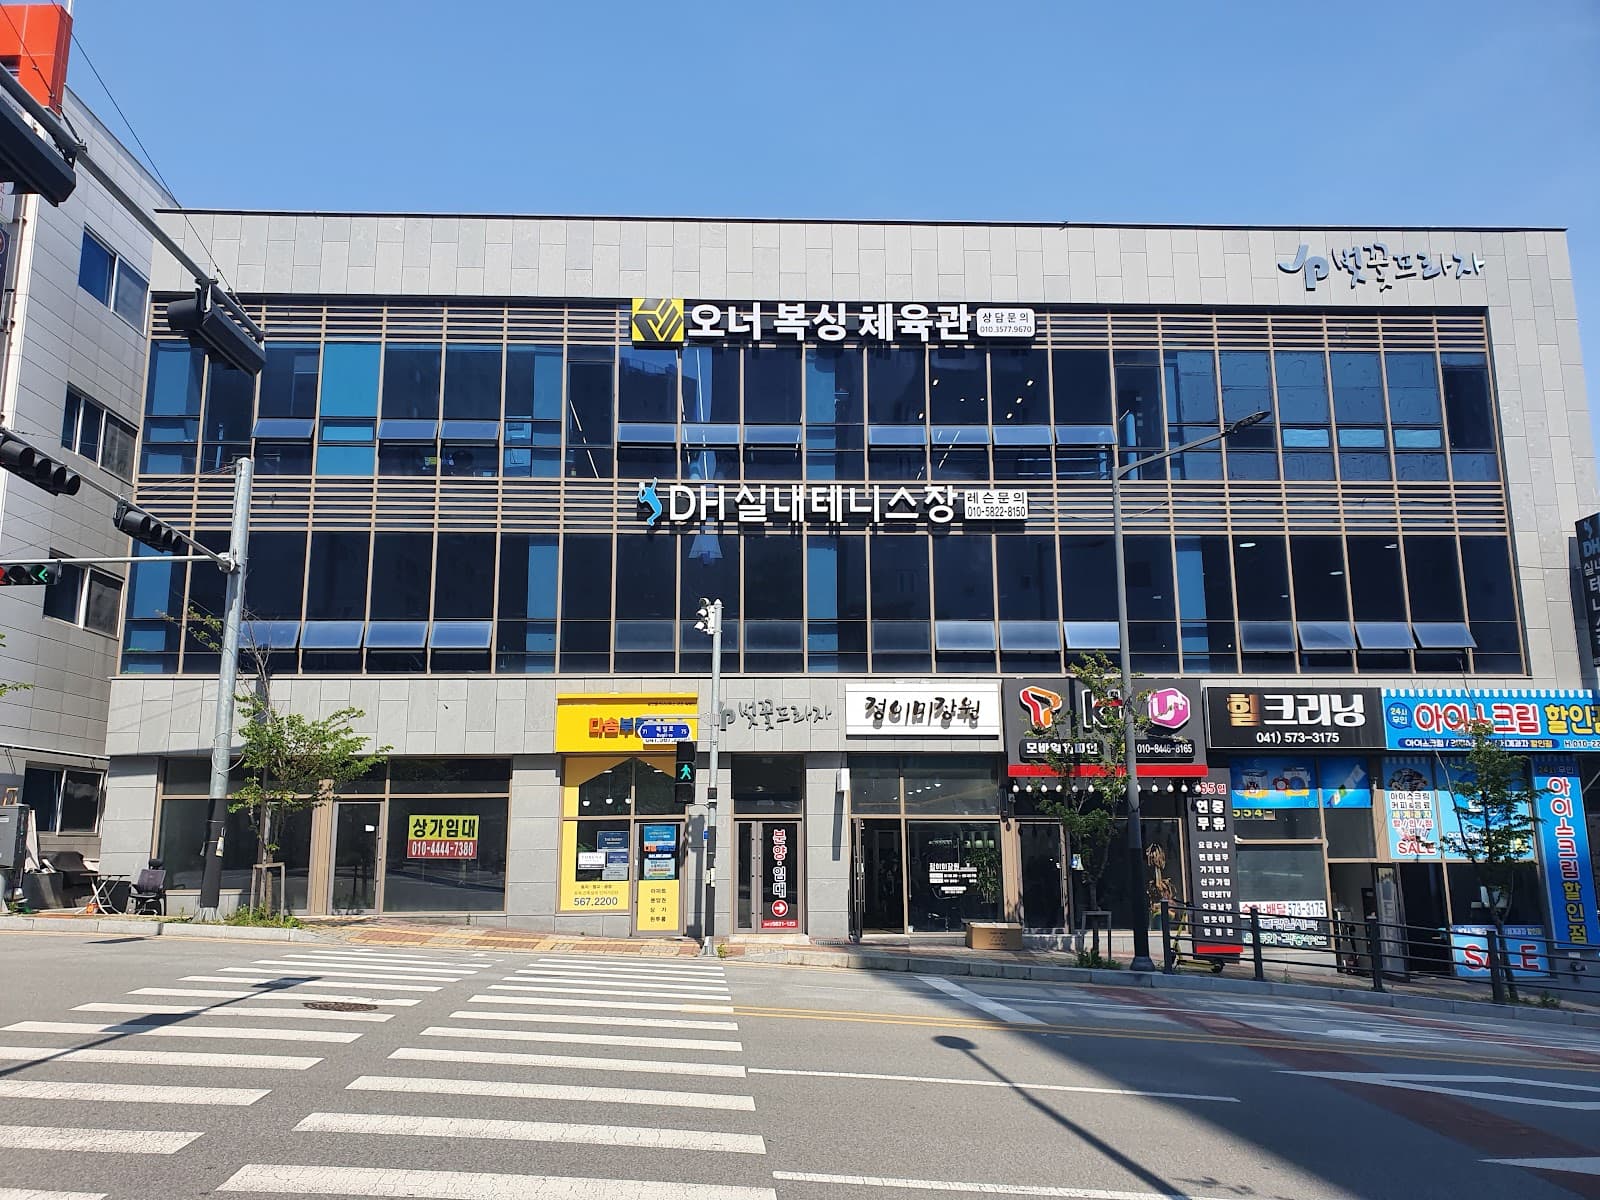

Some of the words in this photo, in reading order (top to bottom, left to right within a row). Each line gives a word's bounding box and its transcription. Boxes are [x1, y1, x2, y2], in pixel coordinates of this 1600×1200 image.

[687, 303, 761, 339] 오너
[774, 303, 846, 341] 복싱
[859, 303, 971, 341] 체육관
[982, 312, 1030, 324] 상담문의
[980, 325, 1032, 334] 010.3577.9670
[967, 491, 1025, 504] 레슨문의
[967, 505, 1027, 518] 010-5822-8150
[865, 697, 980, 728] 정이미장원
[1284, 732, 1340, 744] 573-3175
[413, 818, 476, 838] 상가임대
[1197, 817, 1225, 831] 무휴
[412, 841, 474, 857] 010-4444-7380
[1398, 842, 1436, 854] SALE
[574, 896, 618, 906] 567.2200
